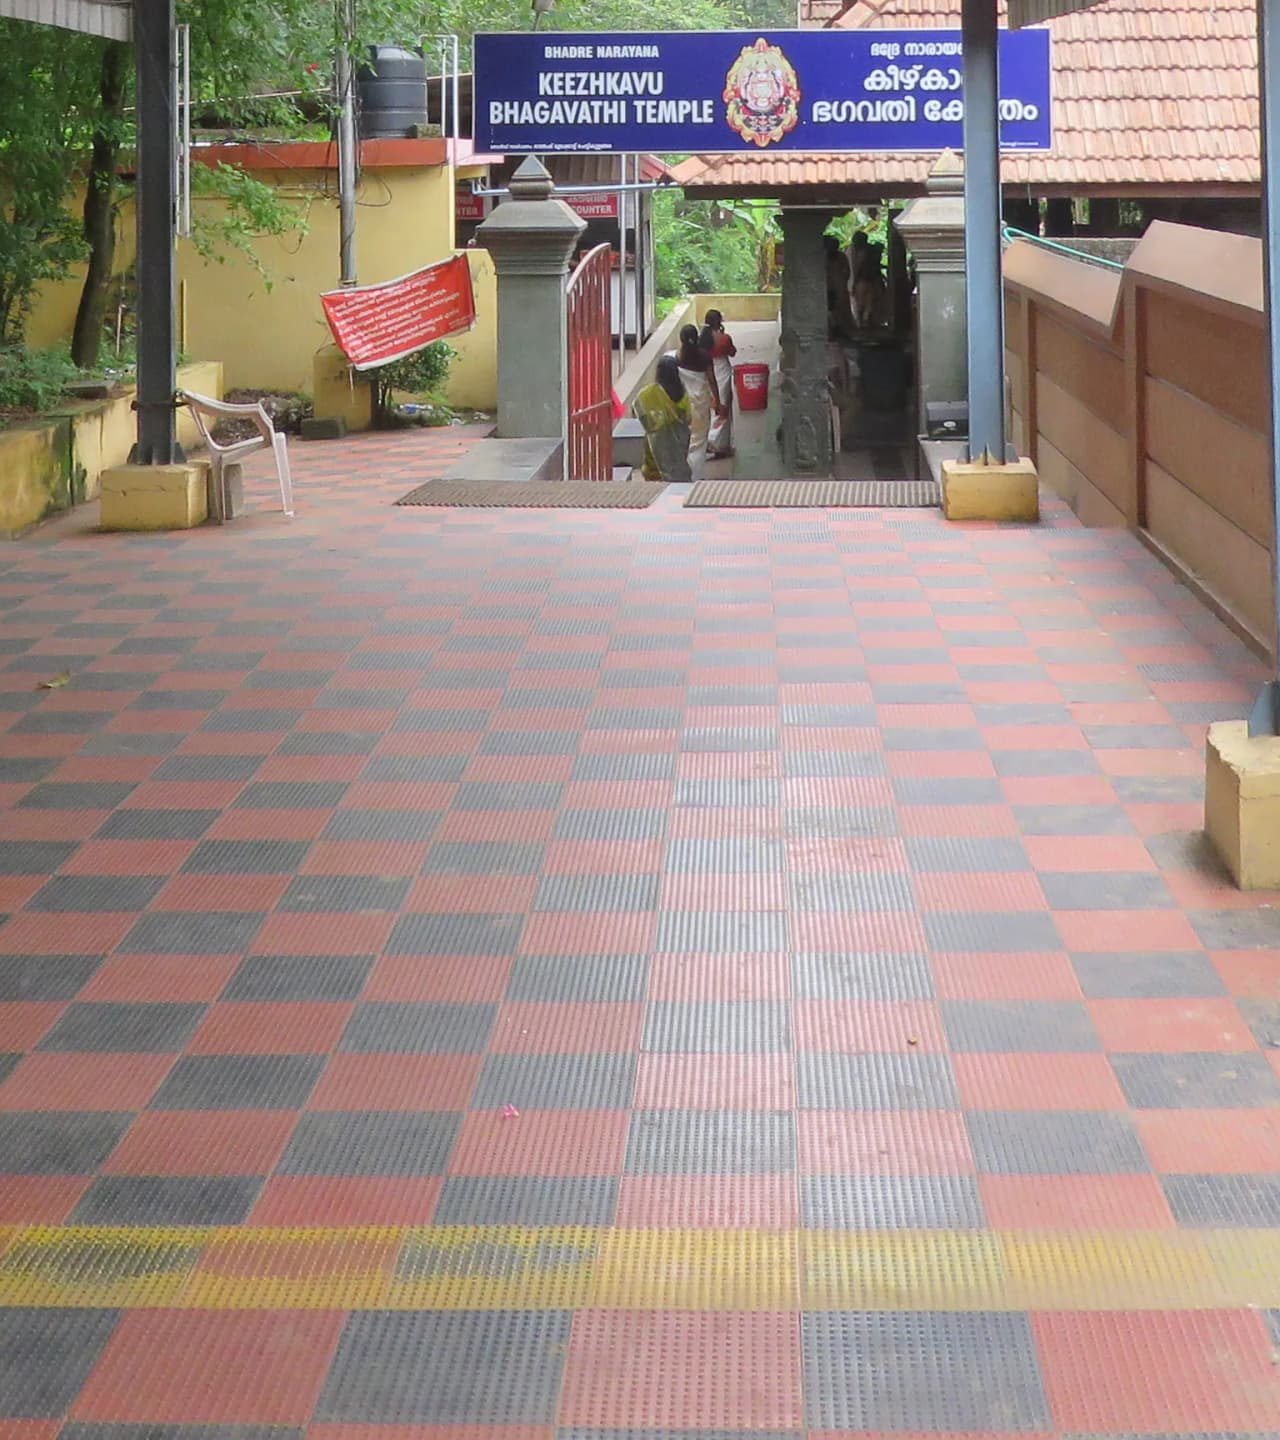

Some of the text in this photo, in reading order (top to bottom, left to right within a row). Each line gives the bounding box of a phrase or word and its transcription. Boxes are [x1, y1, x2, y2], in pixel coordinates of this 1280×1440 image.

[544, 45, 660, 59] BHADRE NARAYANA
[538, 71, 664, 96] KEEZHKAVU
[863, 64, 964, 91] കീഴ്കാ
[489, 100, 714, 124] BHAGAVATHI TEMPLE
[812, 95, 916, 122] ഭഗവതി
